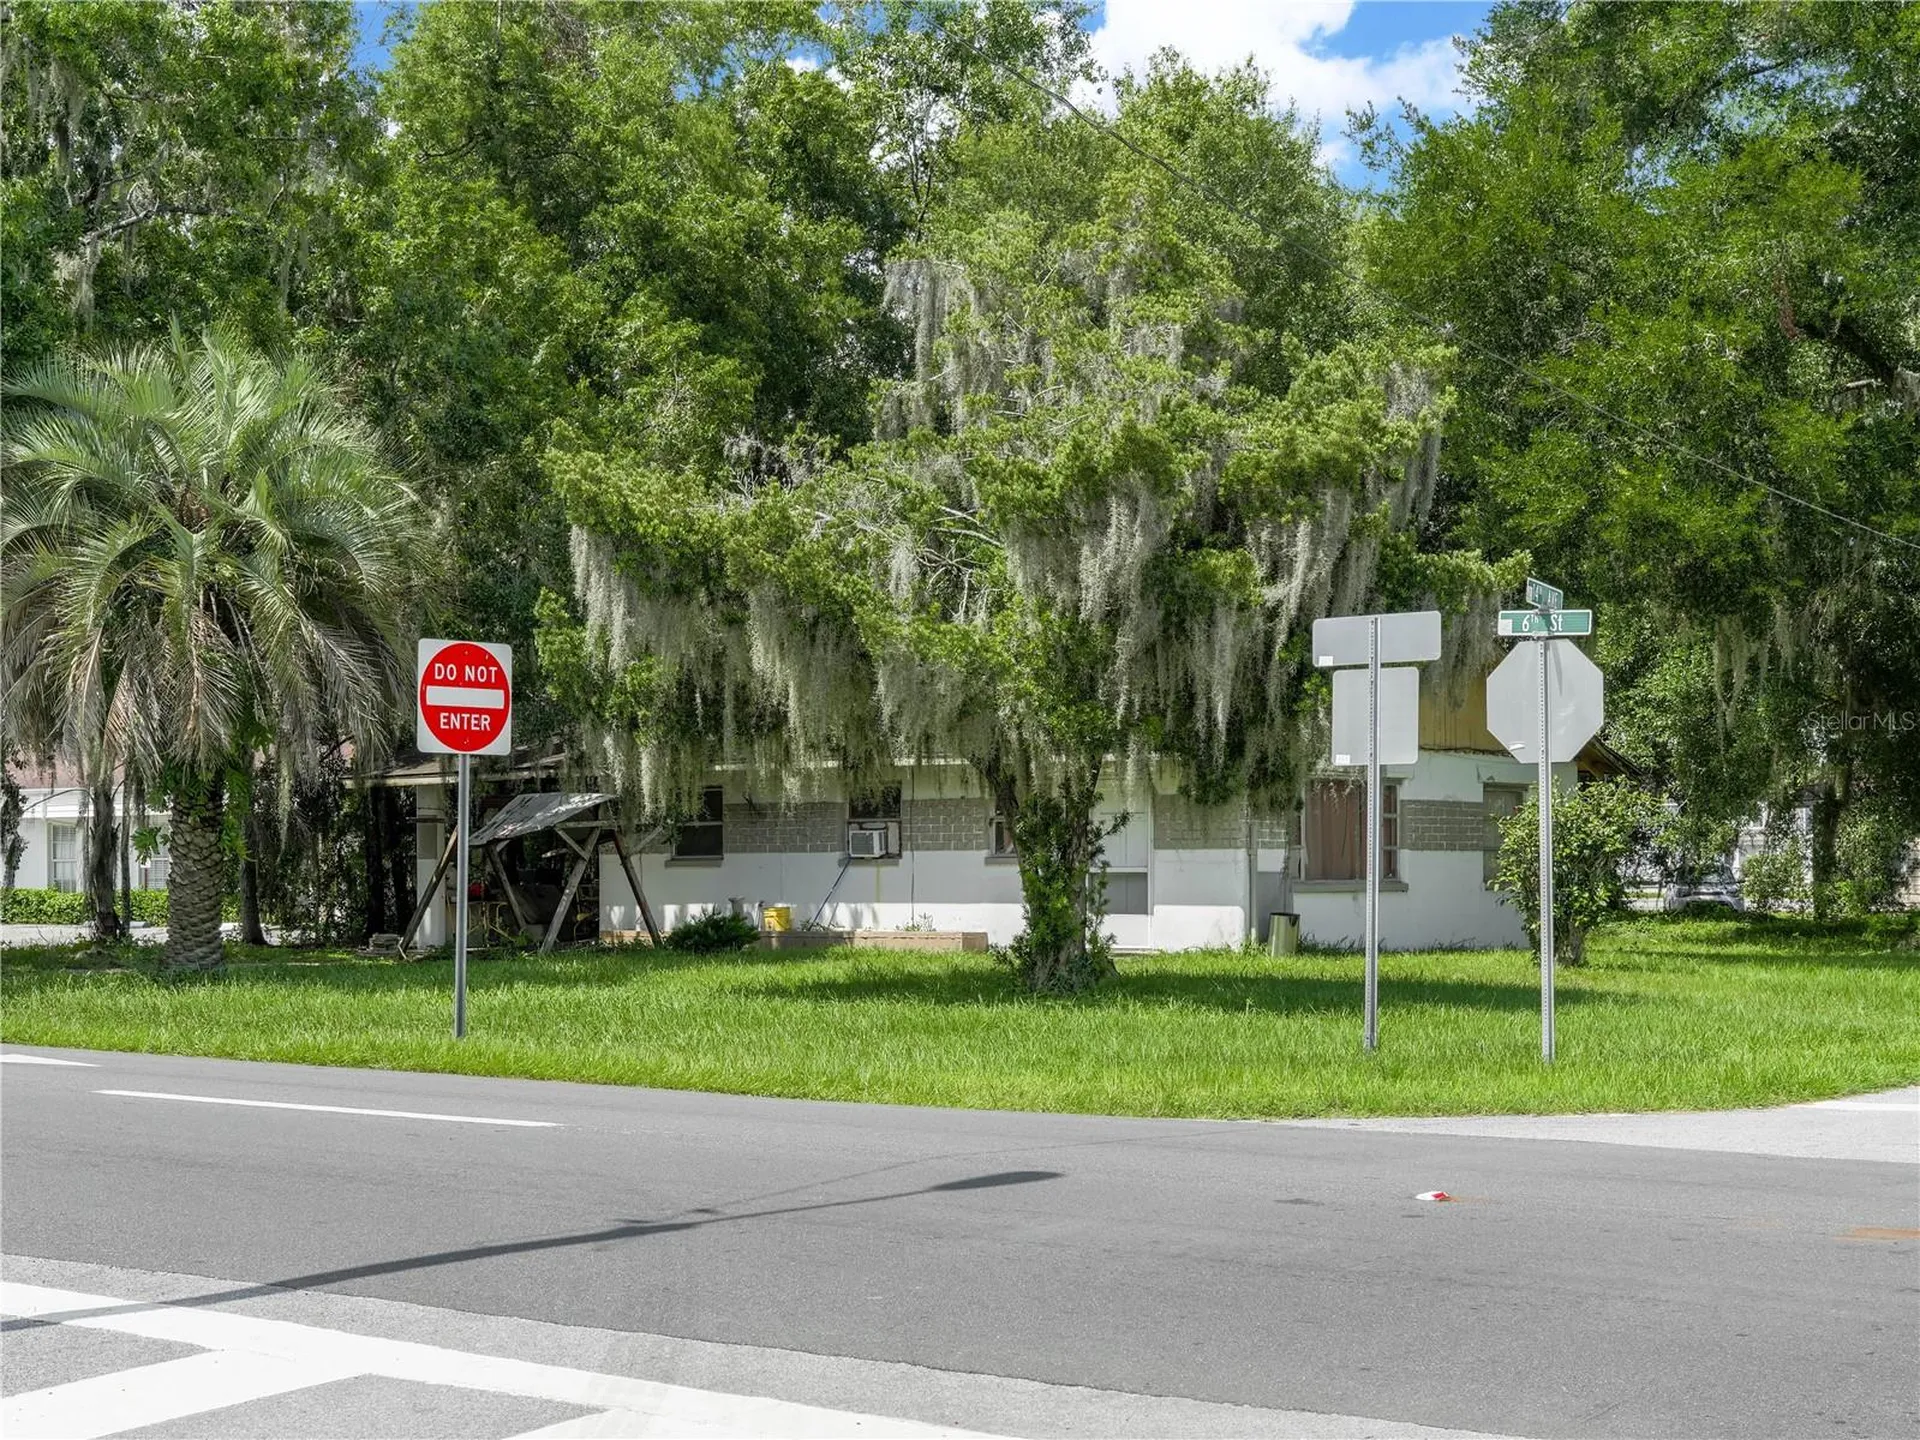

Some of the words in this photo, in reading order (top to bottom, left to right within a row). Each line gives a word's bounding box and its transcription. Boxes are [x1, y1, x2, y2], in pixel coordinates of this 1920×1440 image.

[1549, 613, 1564, 632] St
[434, 663, 457, 680] DO
[464, 664, 498, 683] NOT
[440, 712, 491, 731] ENTER
